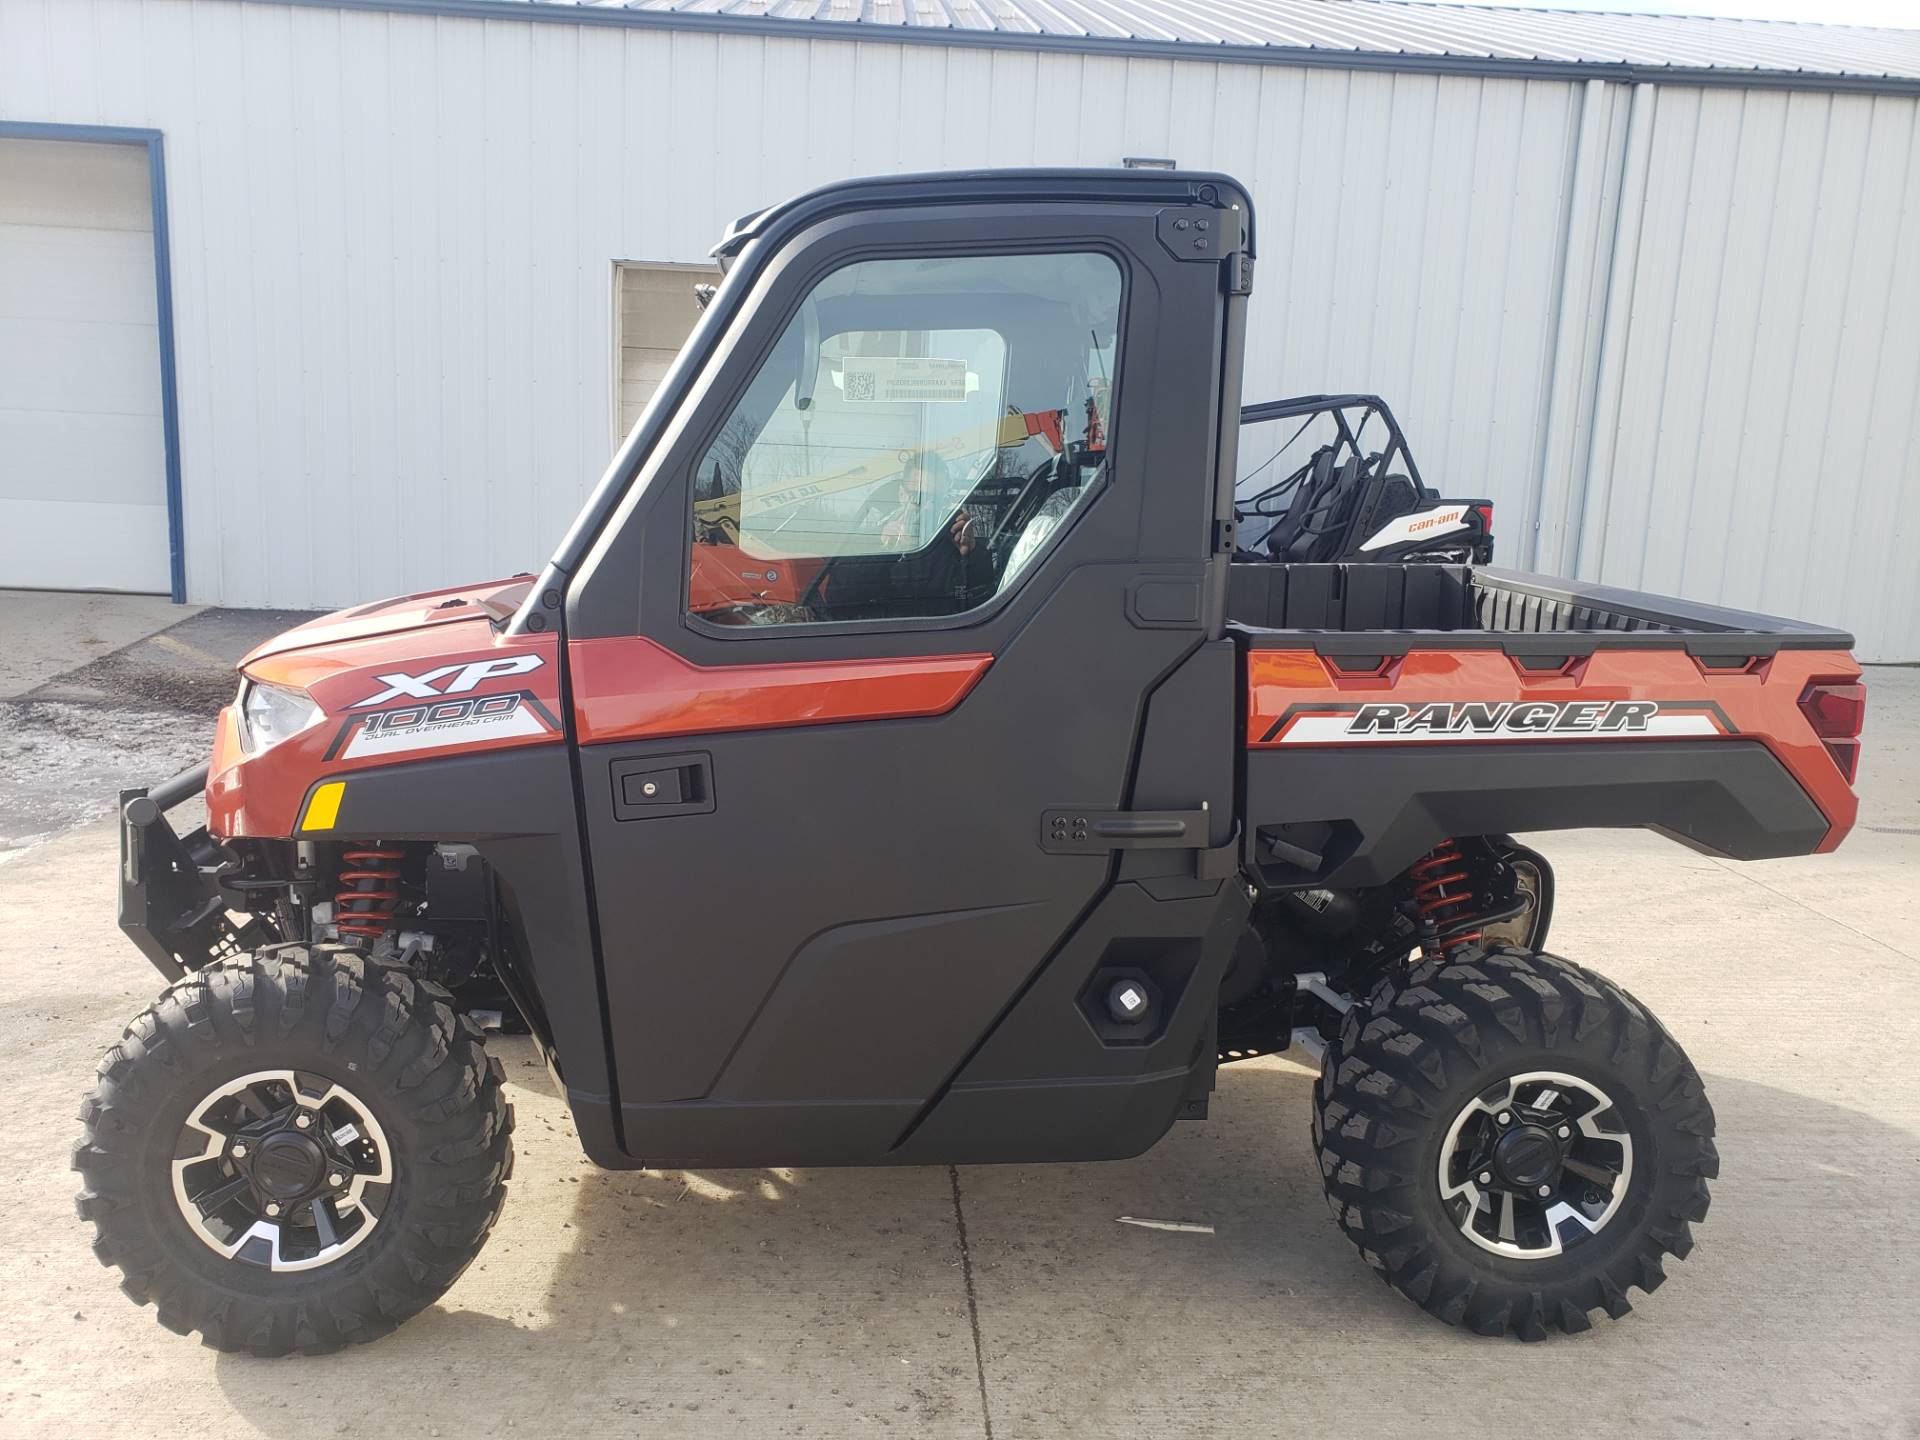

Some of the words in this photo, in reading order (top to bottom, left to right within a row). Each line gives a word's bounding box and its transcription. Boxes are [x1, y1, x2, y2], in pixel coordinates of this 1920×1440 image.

[1408, 511, 1459, 533] can-am
[342, 653, 546, 710] XP
[362, 693, 521, 735] 1000
[365, 730, 402, 740] DUAL
[405, 719, 481, 735] OVERHEAD
[483, 714, 514, 724] CAM
[1345, 700, 1659, 734] RANGER
